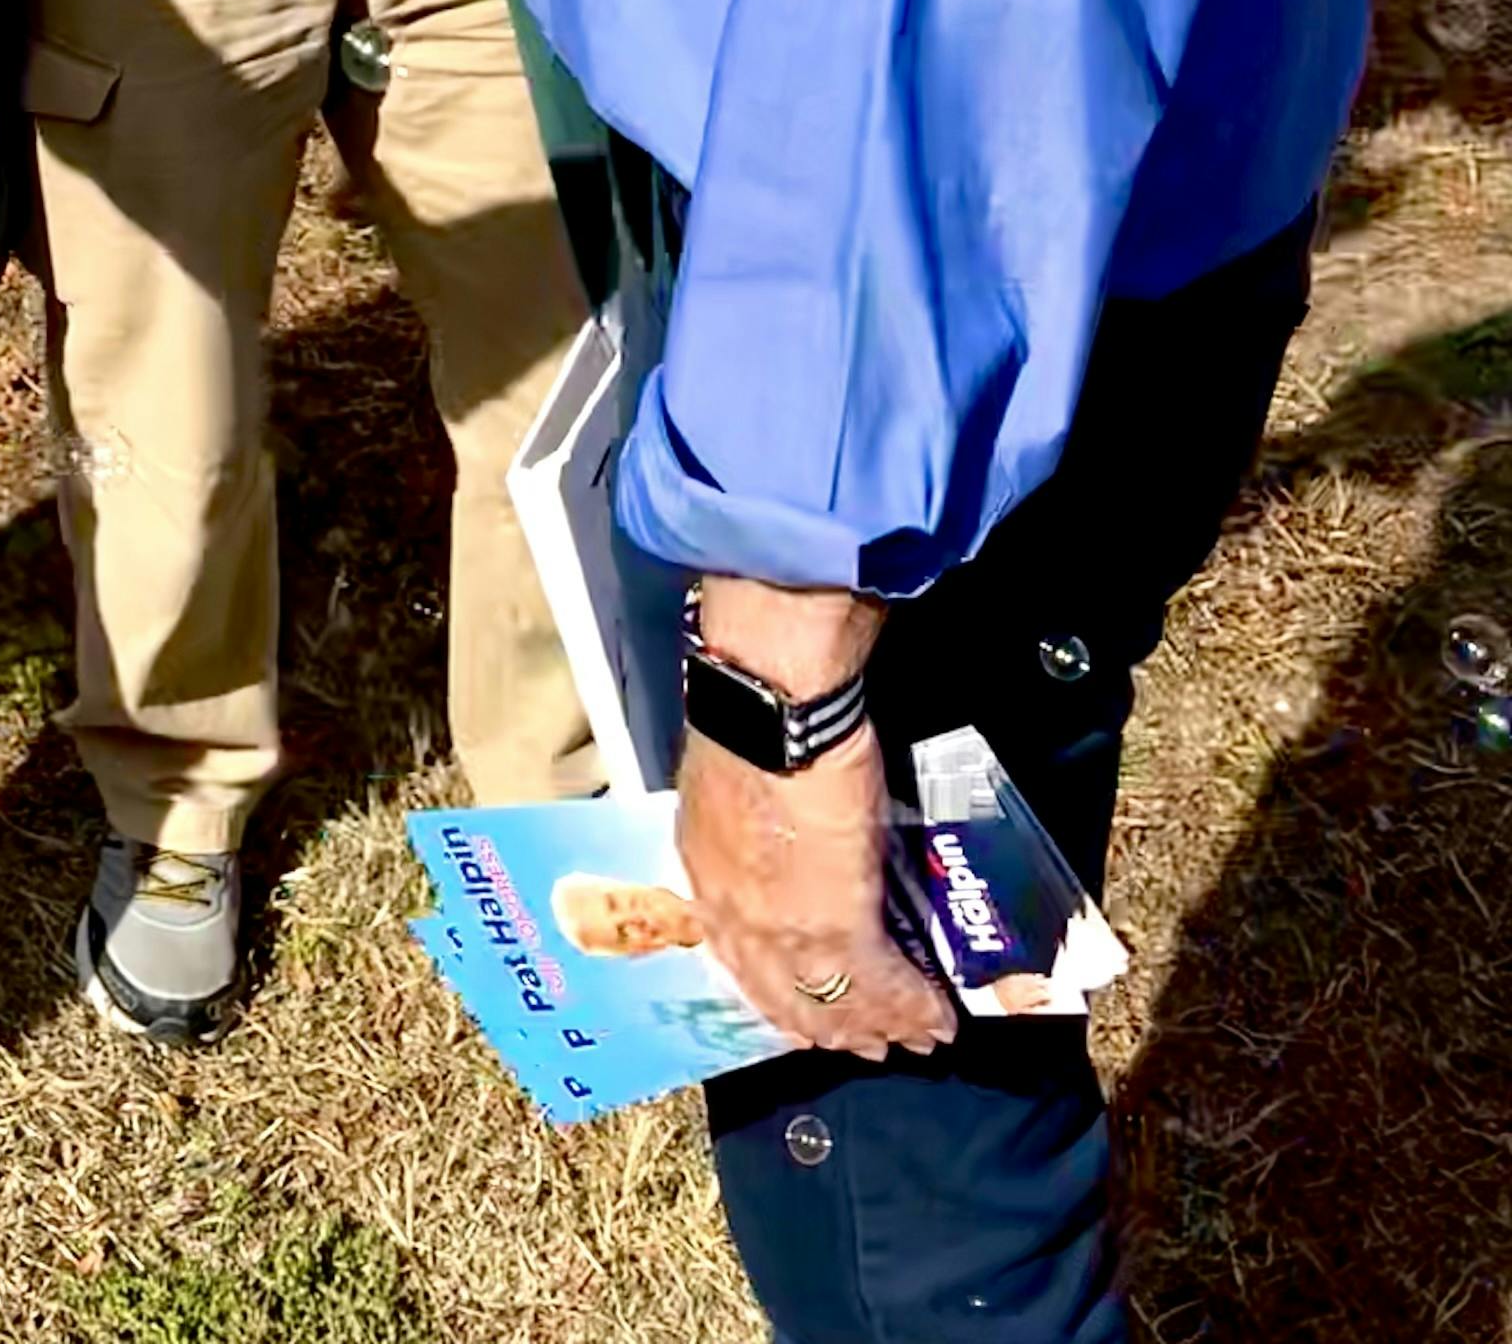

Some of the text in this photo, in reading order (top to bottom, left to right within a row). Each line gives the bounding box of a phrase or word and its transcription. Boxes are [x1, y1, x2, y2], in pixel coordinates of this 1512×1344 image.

[442, 826, 518, 945] Halpin
[932, 832, 1004, 952] Halpin
[504, 954, 555, 1011] Pat
